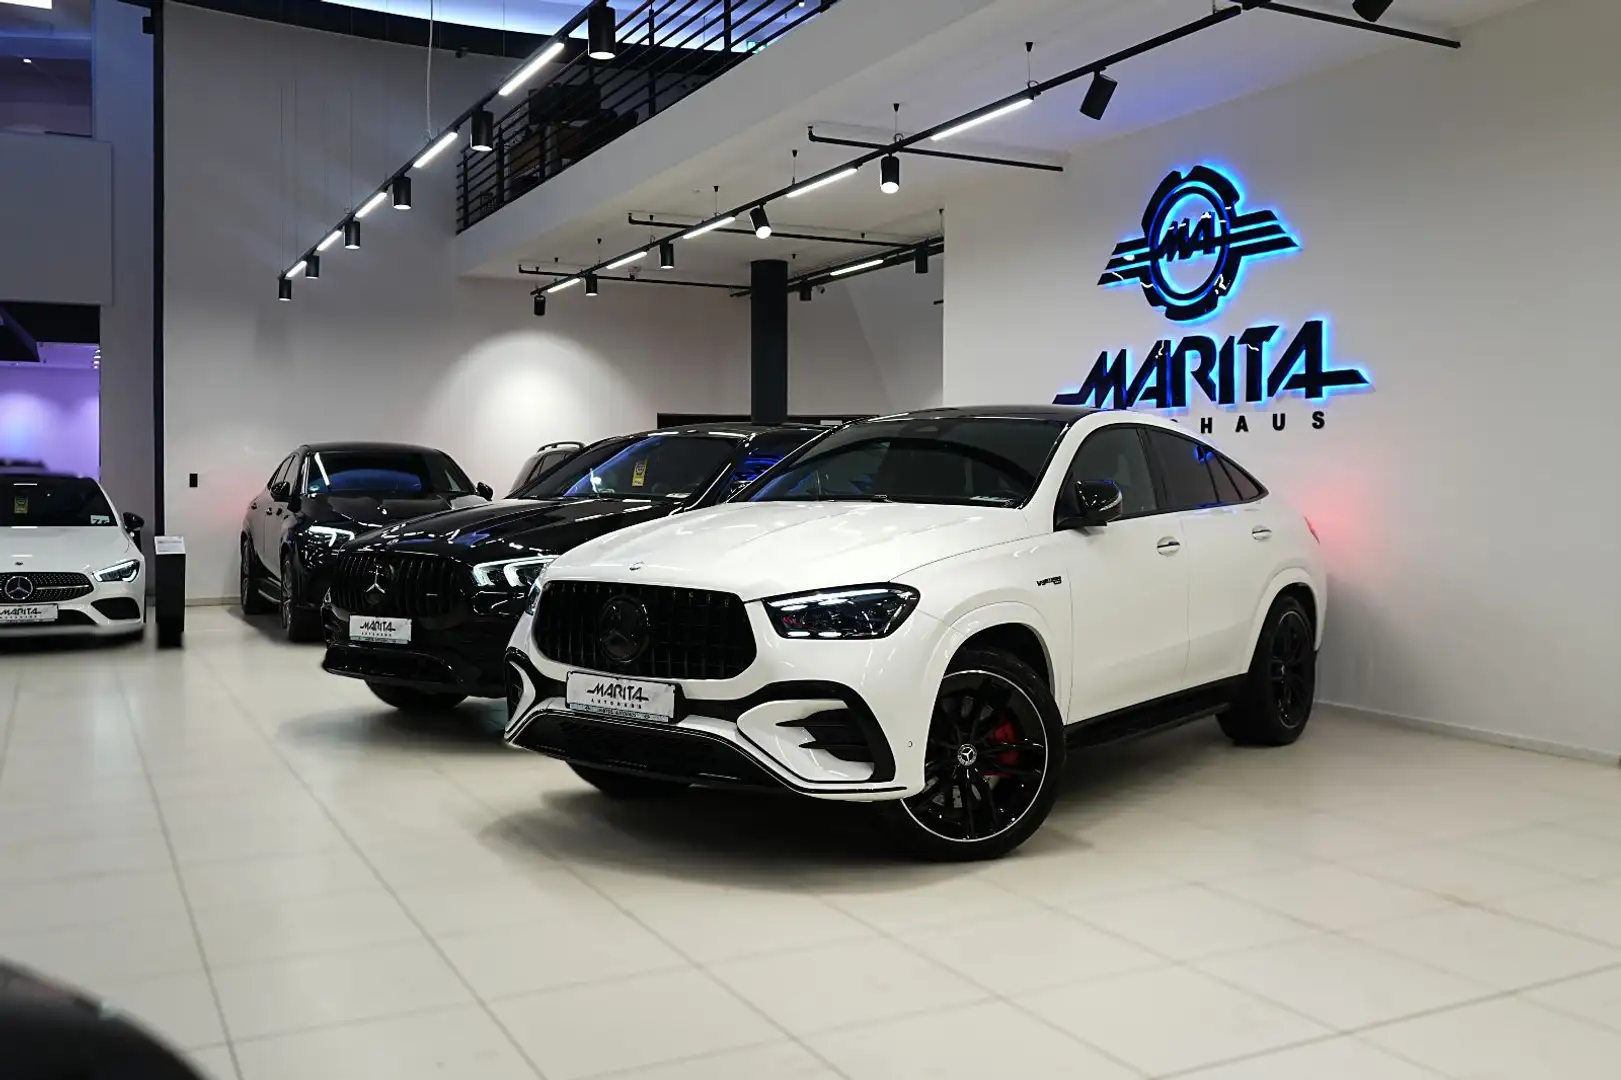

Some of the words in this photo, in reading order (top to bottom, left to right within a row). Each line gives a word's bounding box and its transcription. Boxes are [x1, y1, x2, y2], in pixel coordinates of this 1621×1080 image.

[1052, 320, 1369, 409] MARITA
[1201, 411, 1326, 434] HAUS
[360, 620, 396, 632] MARITA
[586, 682, 649, 703] MARITA
